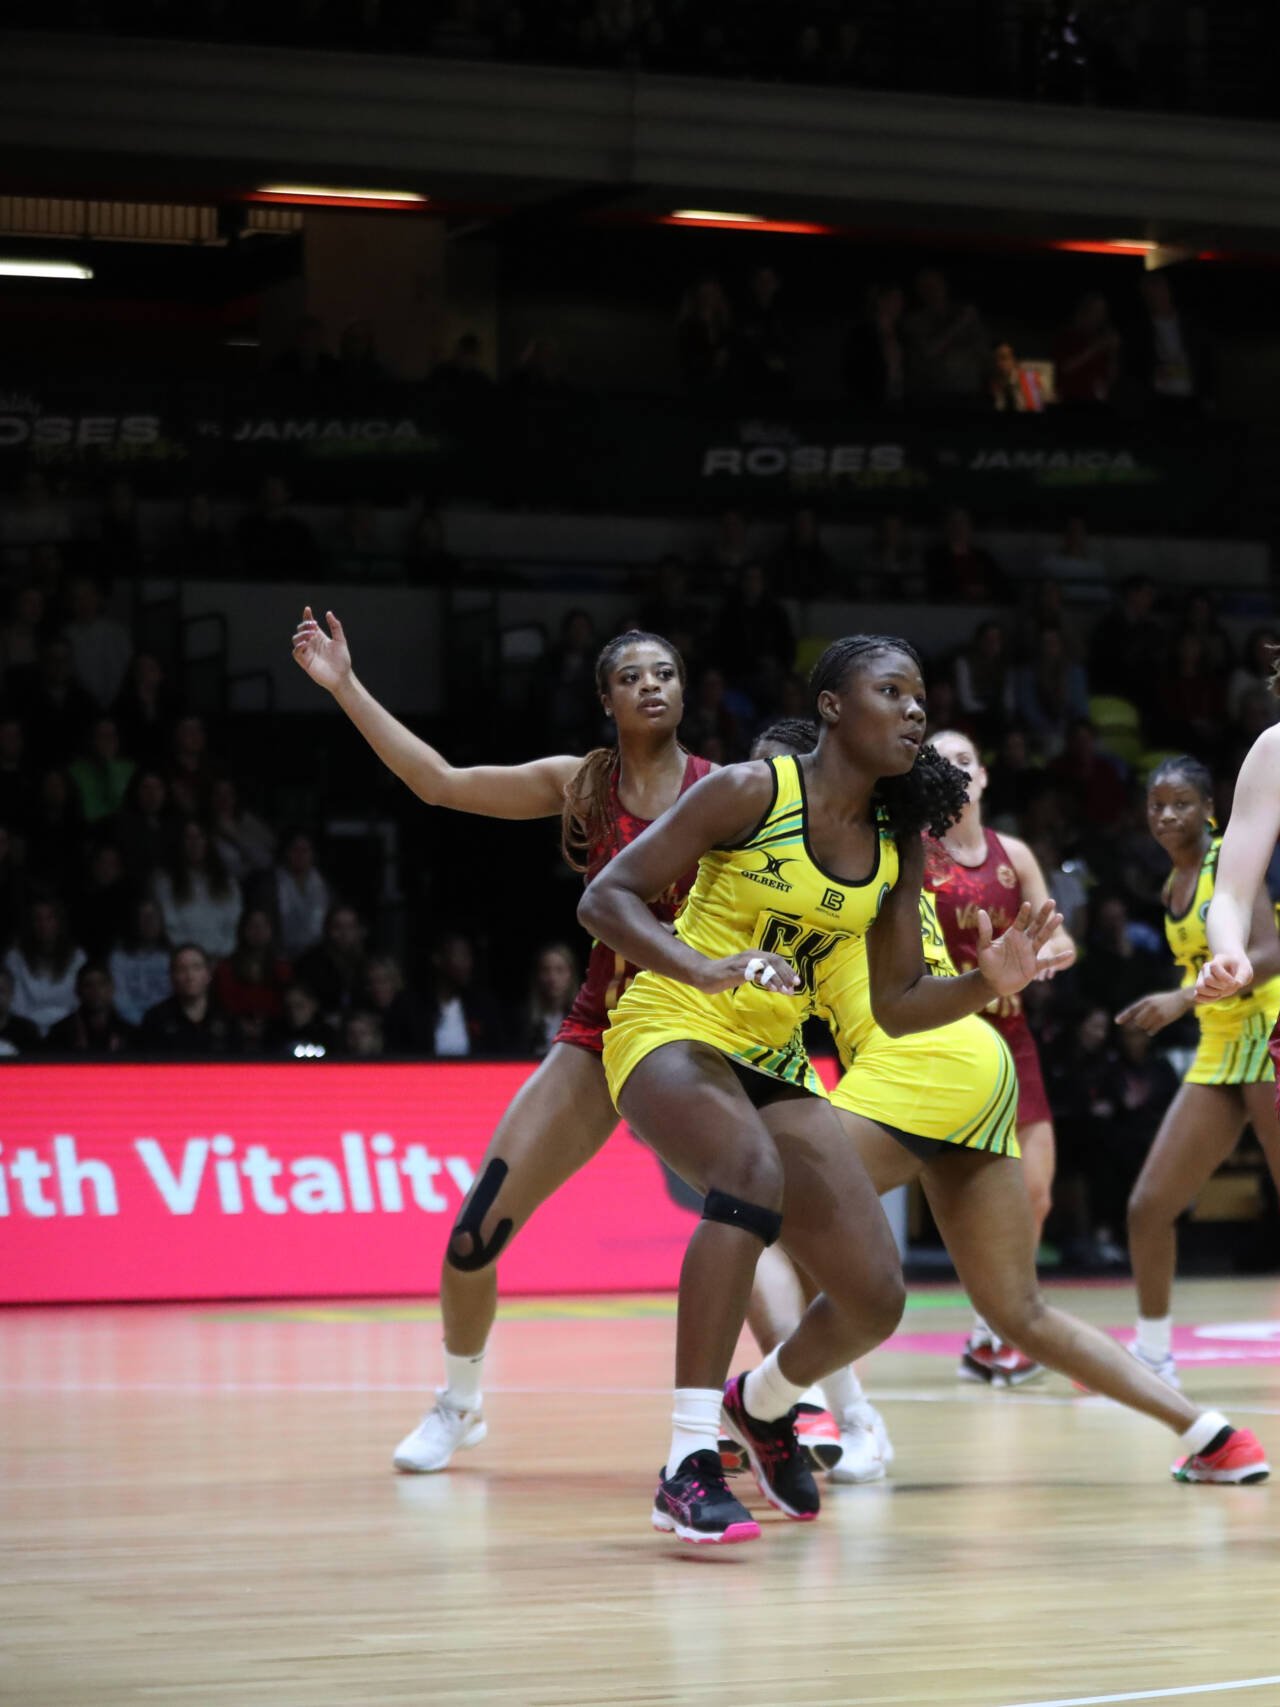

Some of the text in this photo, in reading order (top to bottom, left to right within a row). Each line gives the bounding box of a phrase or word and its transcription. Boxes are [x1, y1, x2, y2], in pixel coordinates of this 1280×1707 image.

[232, 418, 420, 441] JAMAICA
[702, 443, 906, 477] ROSES
[741, 869, 793, 893] GILBERT
[757, 915, 850, 997] GK
